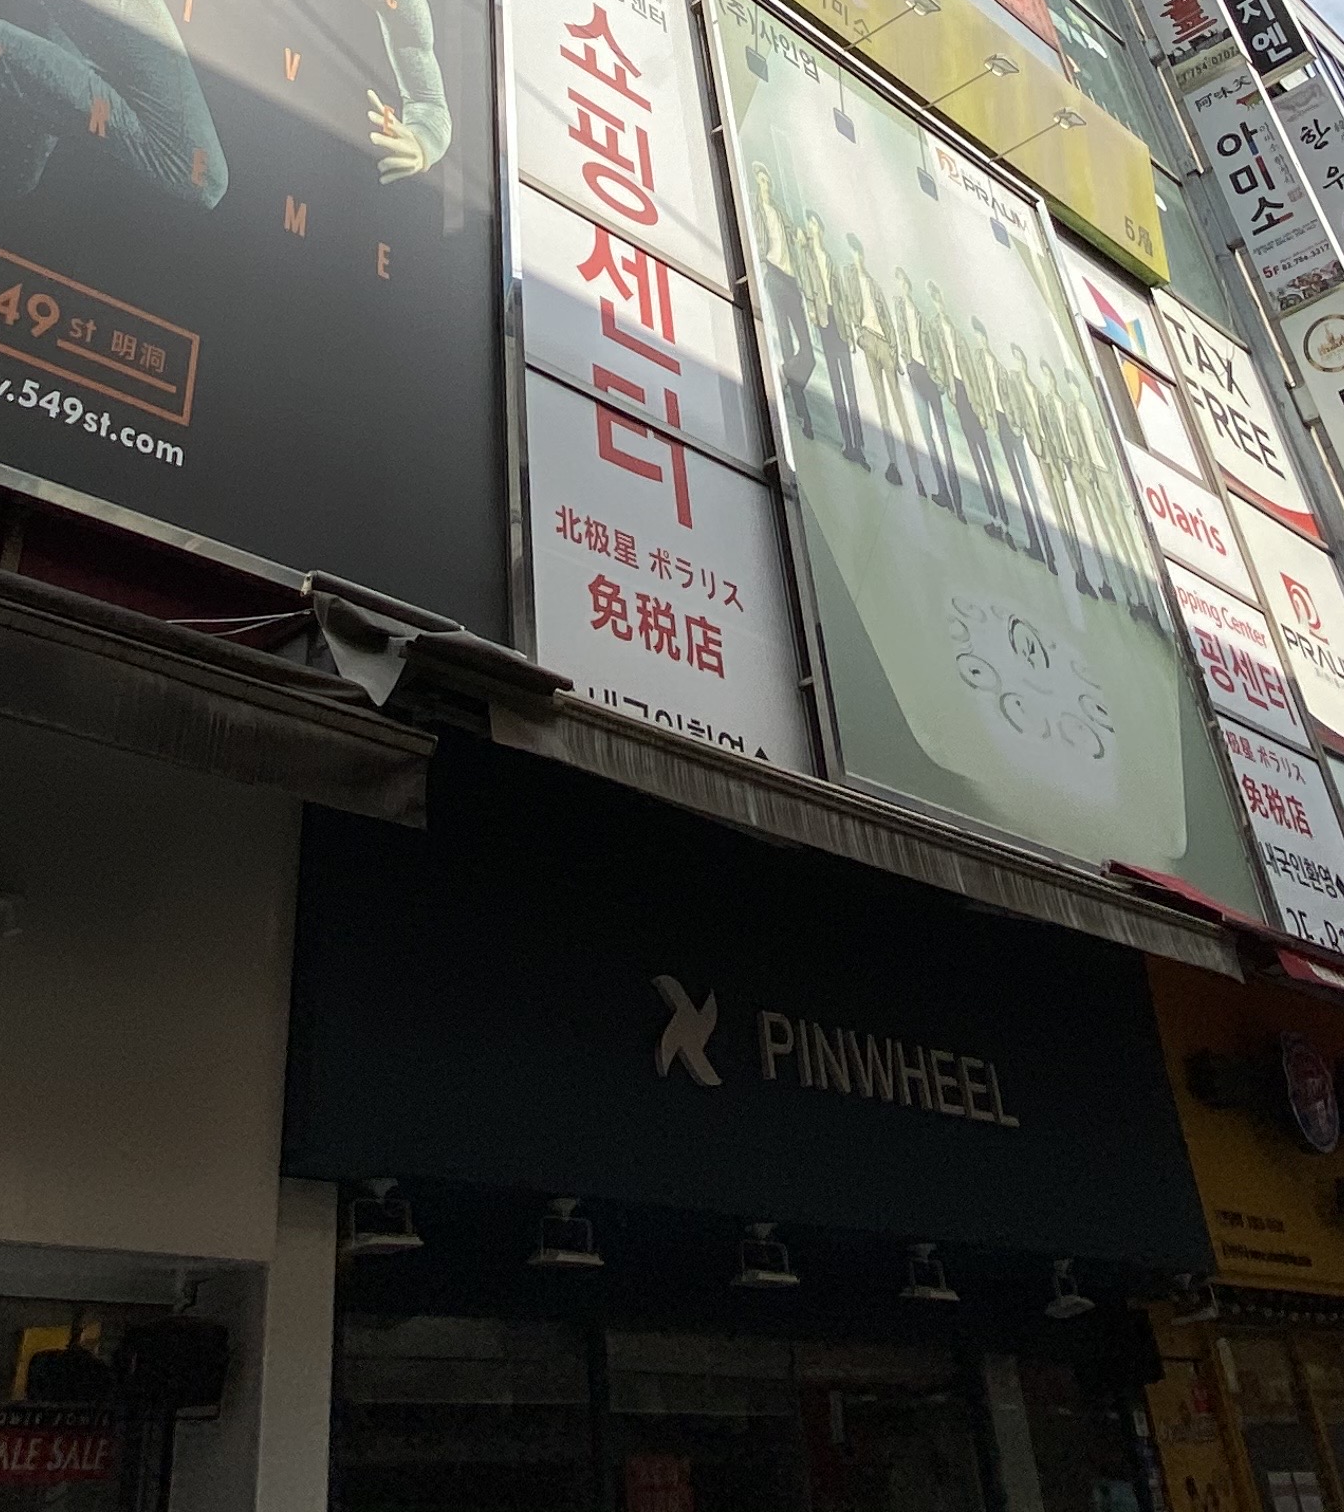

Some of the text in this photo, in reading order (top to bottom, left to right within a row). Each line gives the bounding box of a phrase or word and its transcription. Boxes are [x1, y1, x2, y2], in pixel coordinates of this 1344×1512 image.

[1216, 121, 1295, 237] 아미소
[559, 2, 693, 530] 쇼핑센터
[69, 314, 98, 344] st
[111, 328, 167, 375] 明洞
[1162, 310, 1250, 408] TAX
[1184, 378, 1287, 481] FREE
[555, 505, 745, 613] 北极星 ポラリス
[1141, 485, 1228, 557] olaris
[588, 573, 726, 680] 免税店
[1219, 604, 1268, 649] Center
[1242, 773, 1313, 839] 免税店
[760, 1009, 1021, 1128] PINWHEEL
[47, 1437, 112, 1472] SALE
